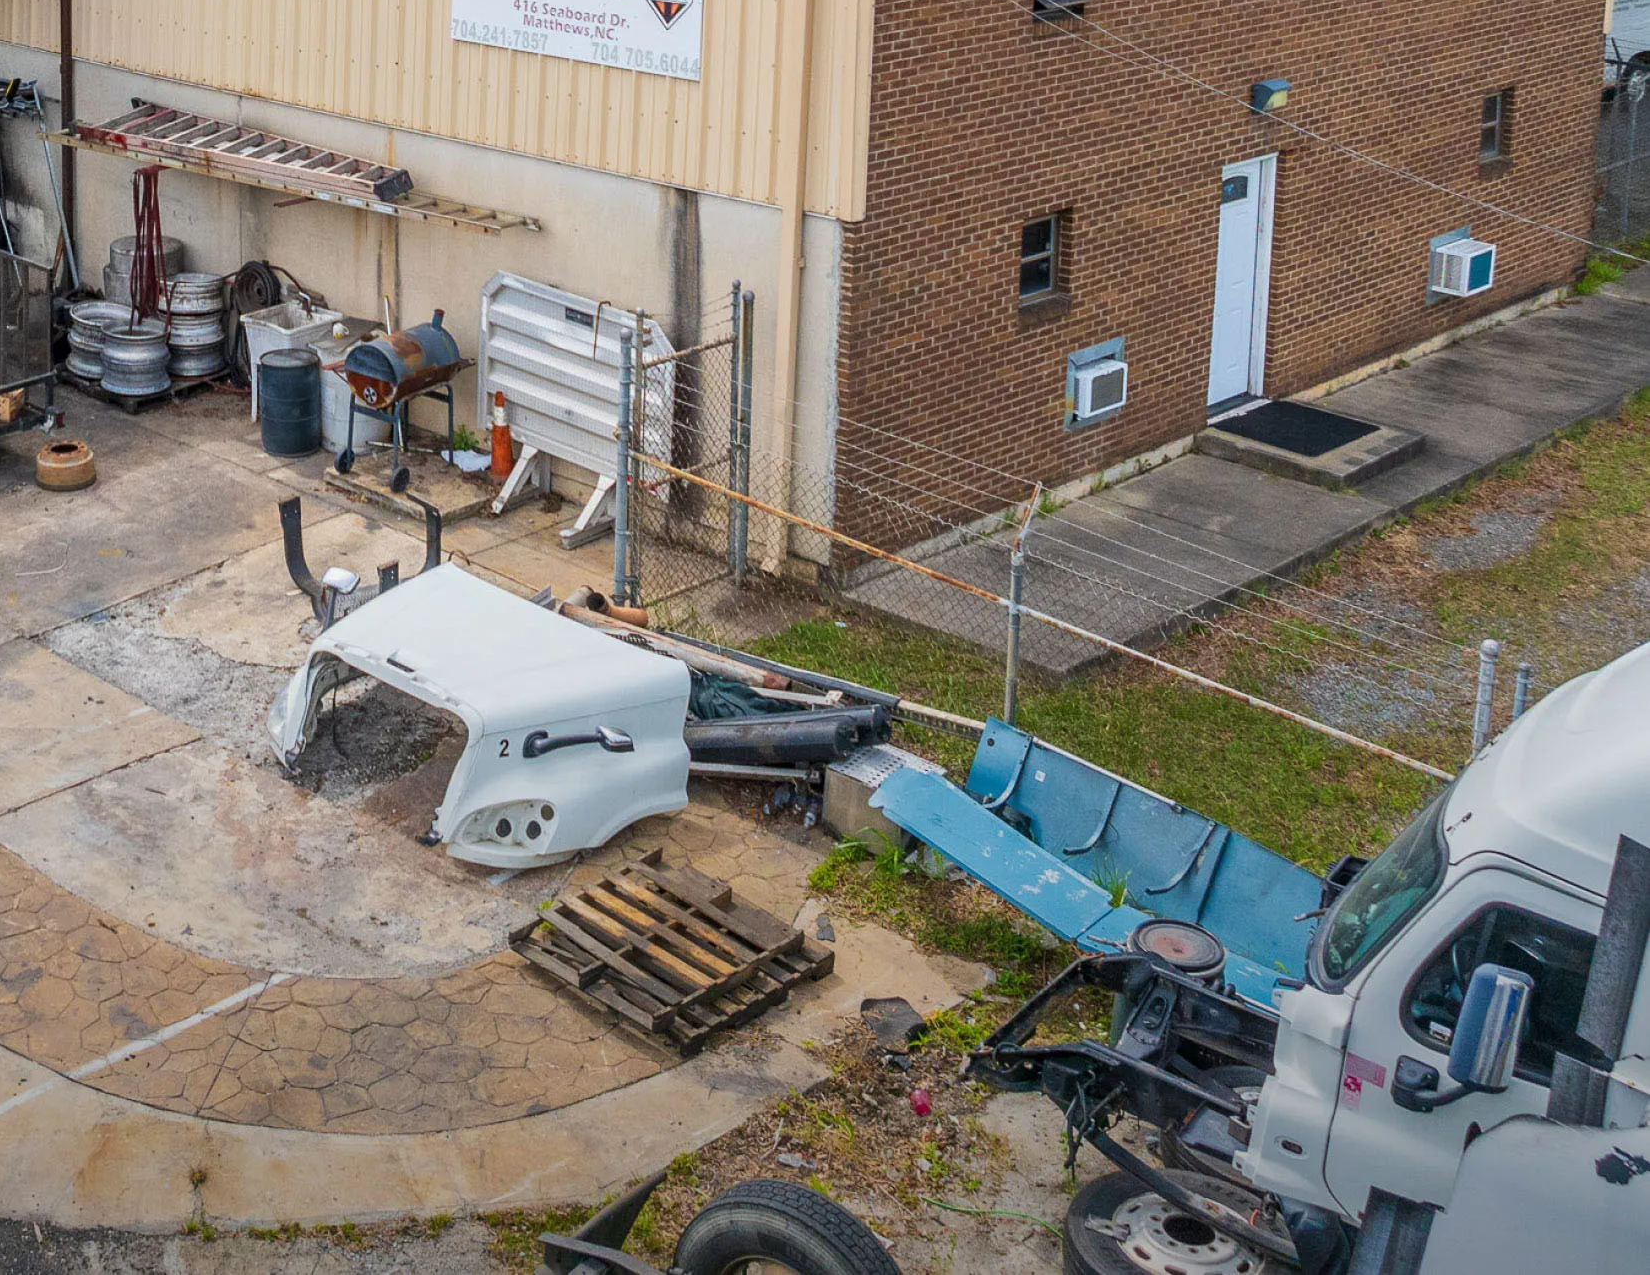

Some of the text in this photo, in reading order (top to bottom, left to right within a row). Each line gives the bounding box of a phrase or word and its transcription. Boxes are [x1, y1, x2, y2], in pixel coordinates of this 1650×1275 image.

[542, 3, 606, 24] Seaboard
[610, 13, 630, 29] Dr.
[499, 738, 510, 758] 2
